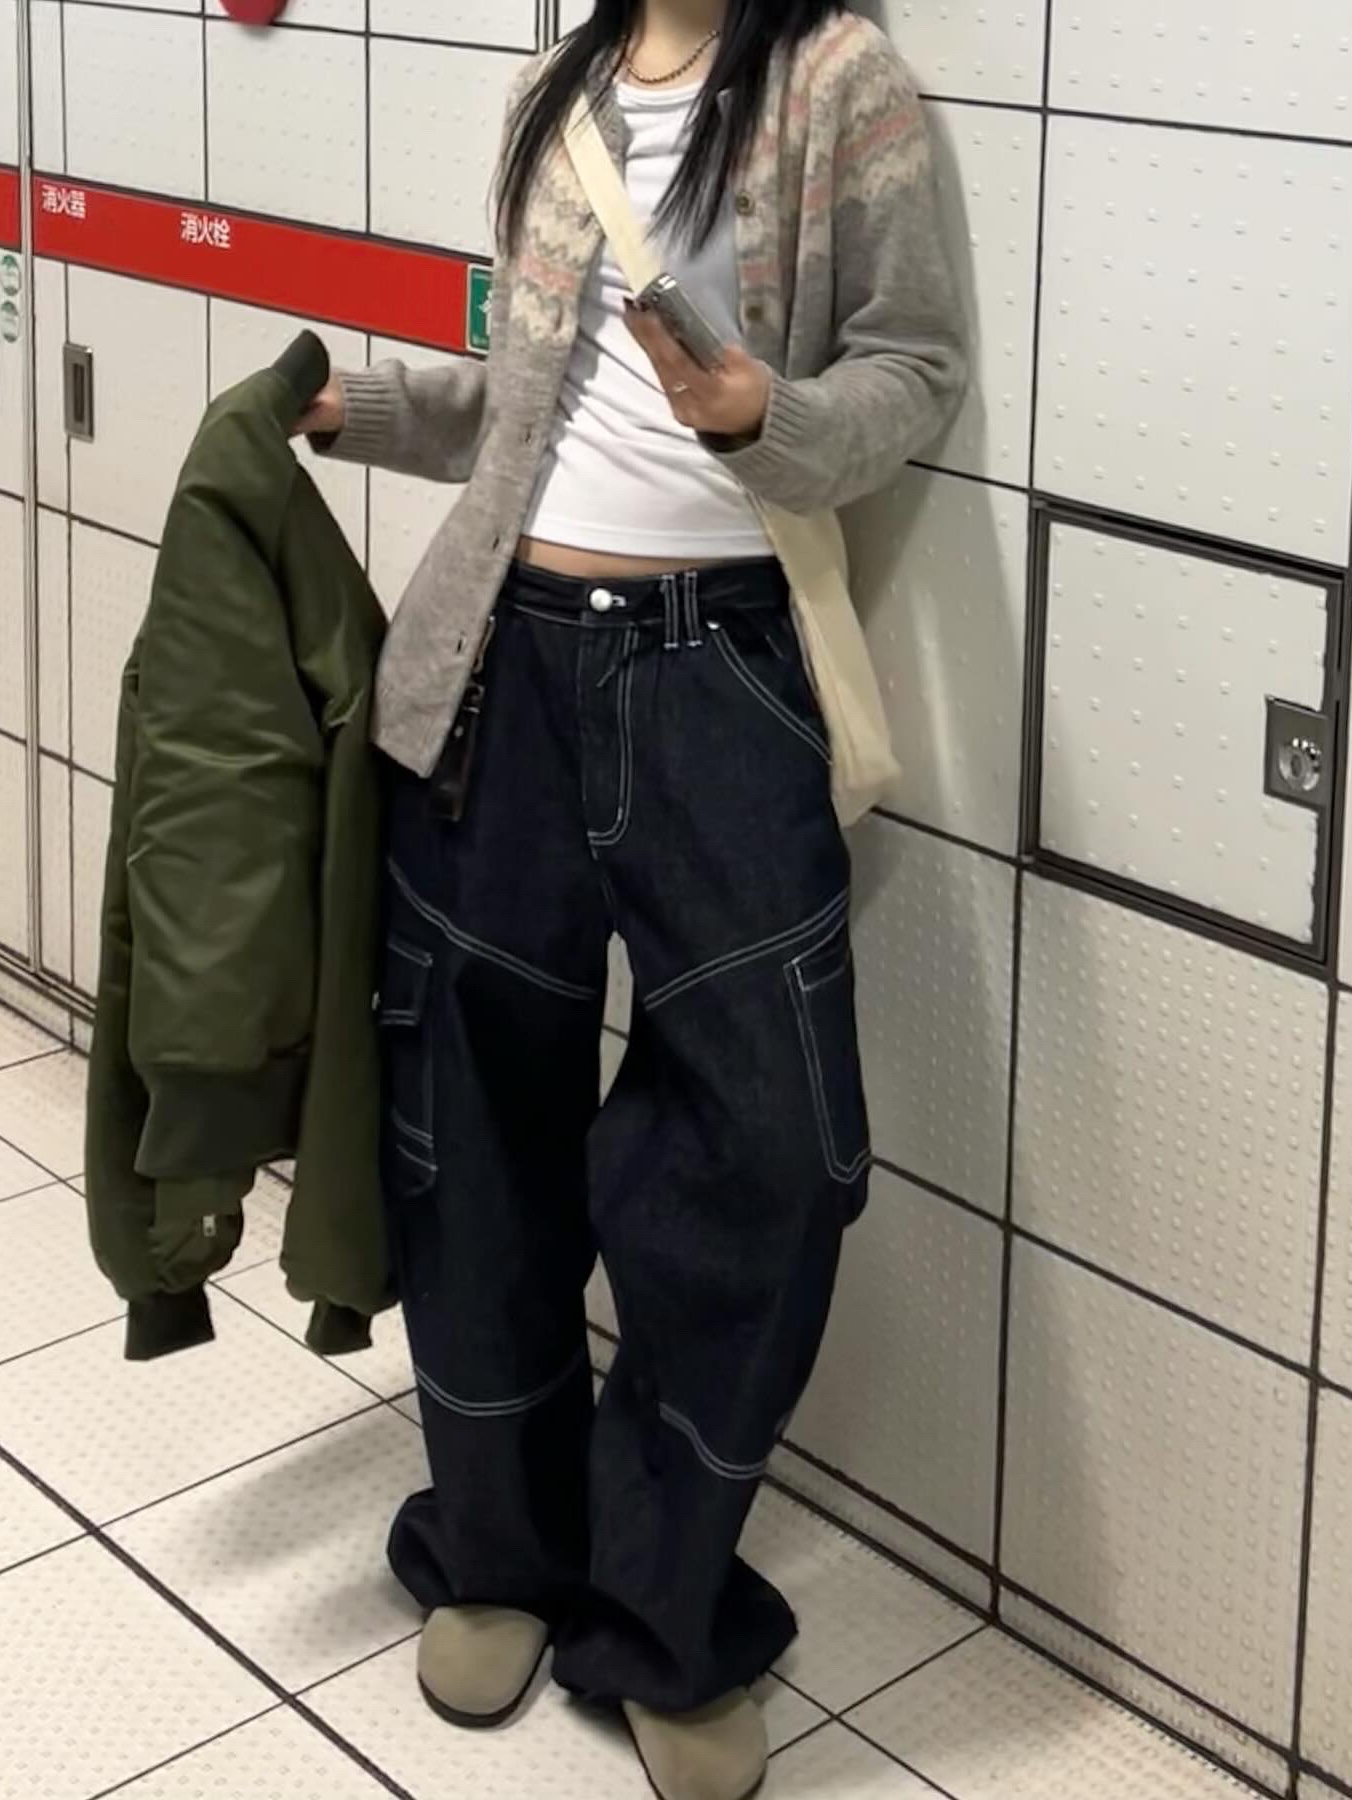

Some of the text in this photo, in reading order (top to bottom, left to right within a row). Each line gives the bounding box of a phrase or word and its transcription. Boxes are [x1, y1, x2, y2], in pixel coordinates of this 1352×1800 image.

[41, 184, 86, 220] 消火器
[180, 212, 231, 249] 消火栓
